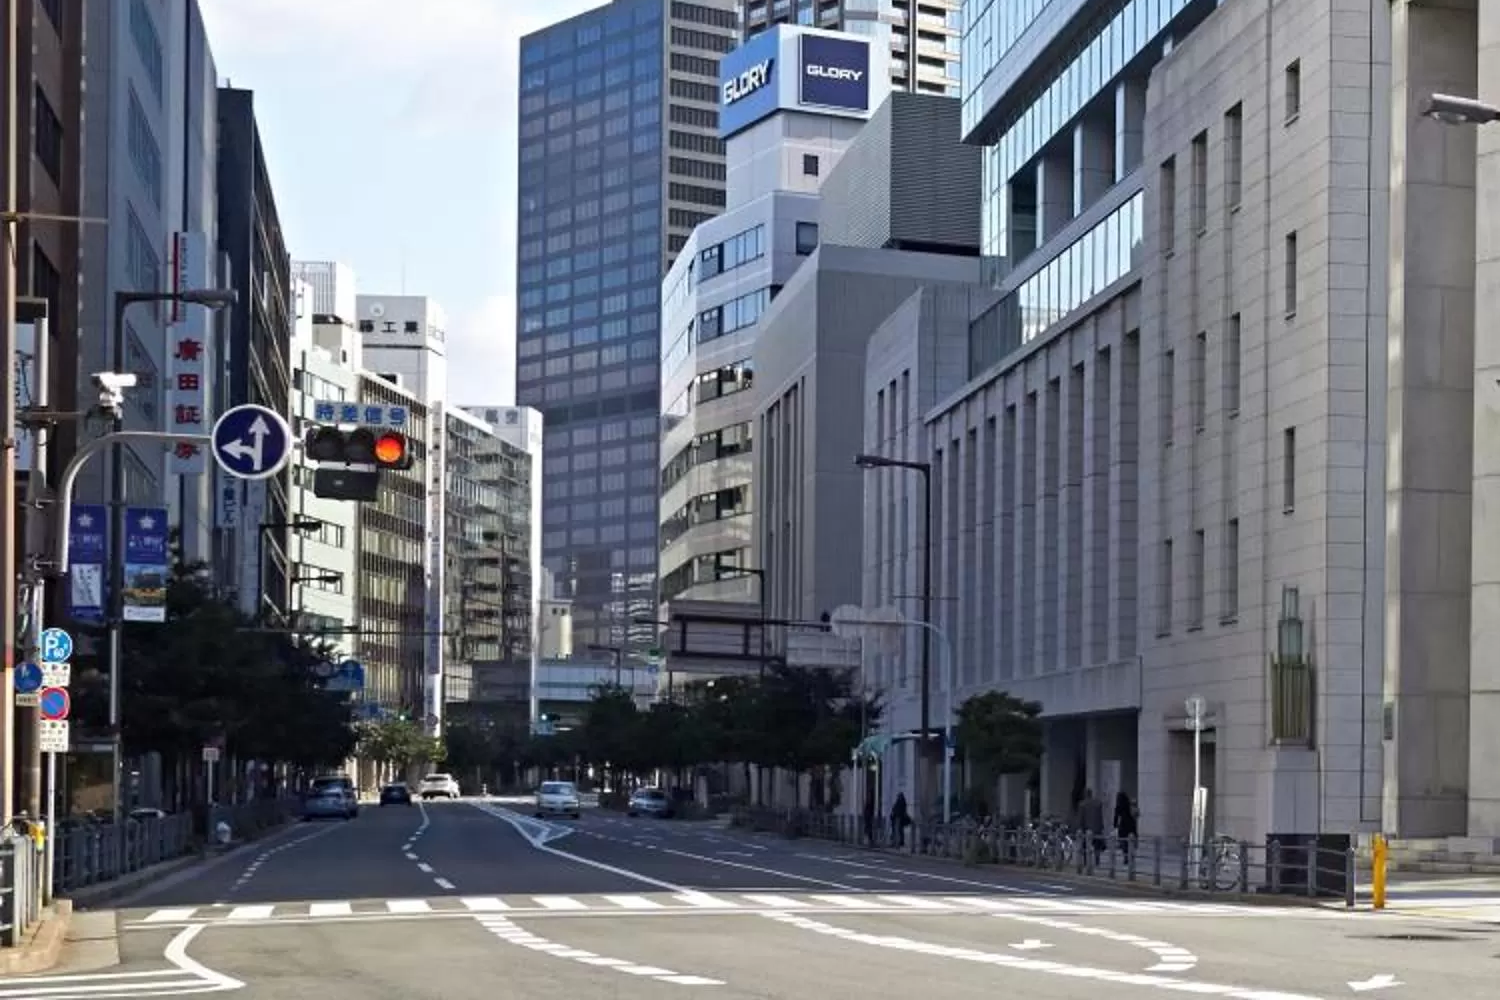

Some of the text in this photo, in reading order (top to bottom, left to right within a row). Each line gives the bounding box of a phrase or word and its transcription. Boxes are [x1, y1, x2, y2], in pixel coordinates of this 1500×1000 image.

[723, 58, 770, 104] GLORY
[806, 64, 863, 81] GLORY
[315, 404, 406, 425] 時差信号
